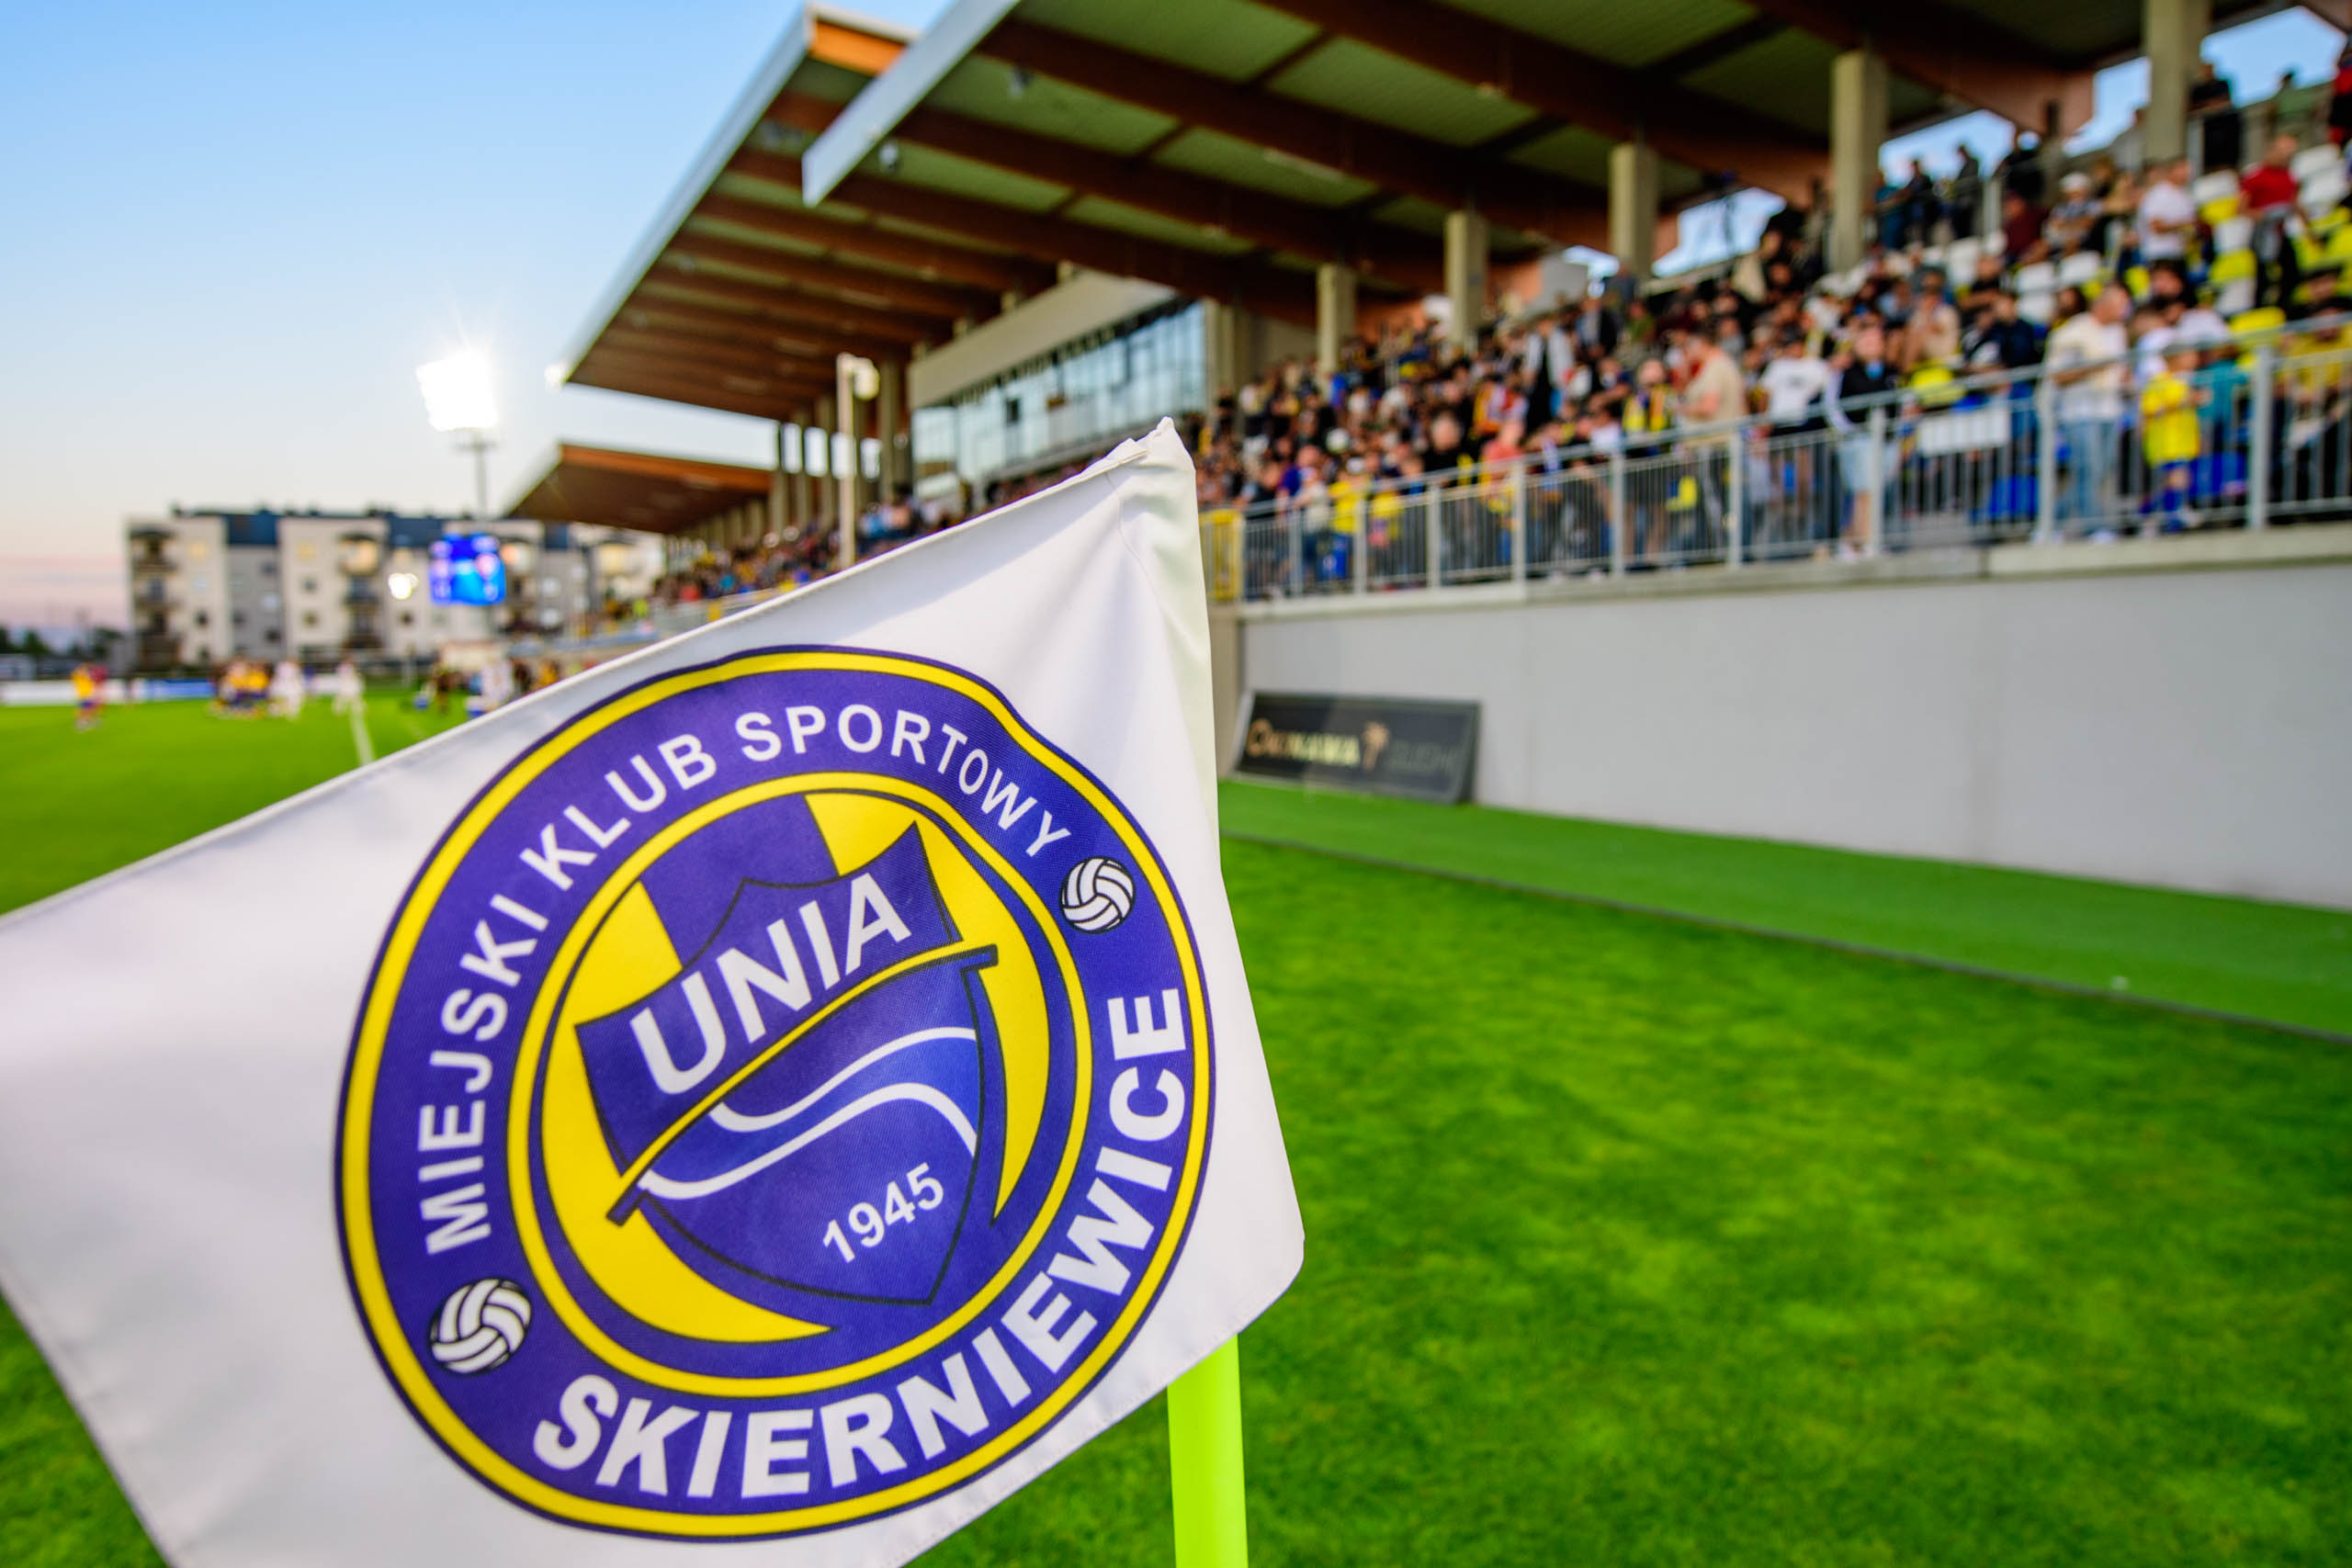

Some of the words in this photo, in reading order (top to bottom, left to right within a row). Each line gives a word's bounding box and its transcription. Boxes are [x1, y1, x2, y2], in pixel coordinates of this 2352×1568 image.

[418, 894, 549, 1255] MIEJSKI
[519, 734, 717, 890] KLUB
[735, 704, 1071, 857] SPORTOWY
[629, 873, 912, 1095] UNIA
[533, 988, 1187, 1499] SKIERNIEWICE
[822, 1162, 944, 1263] 1945
